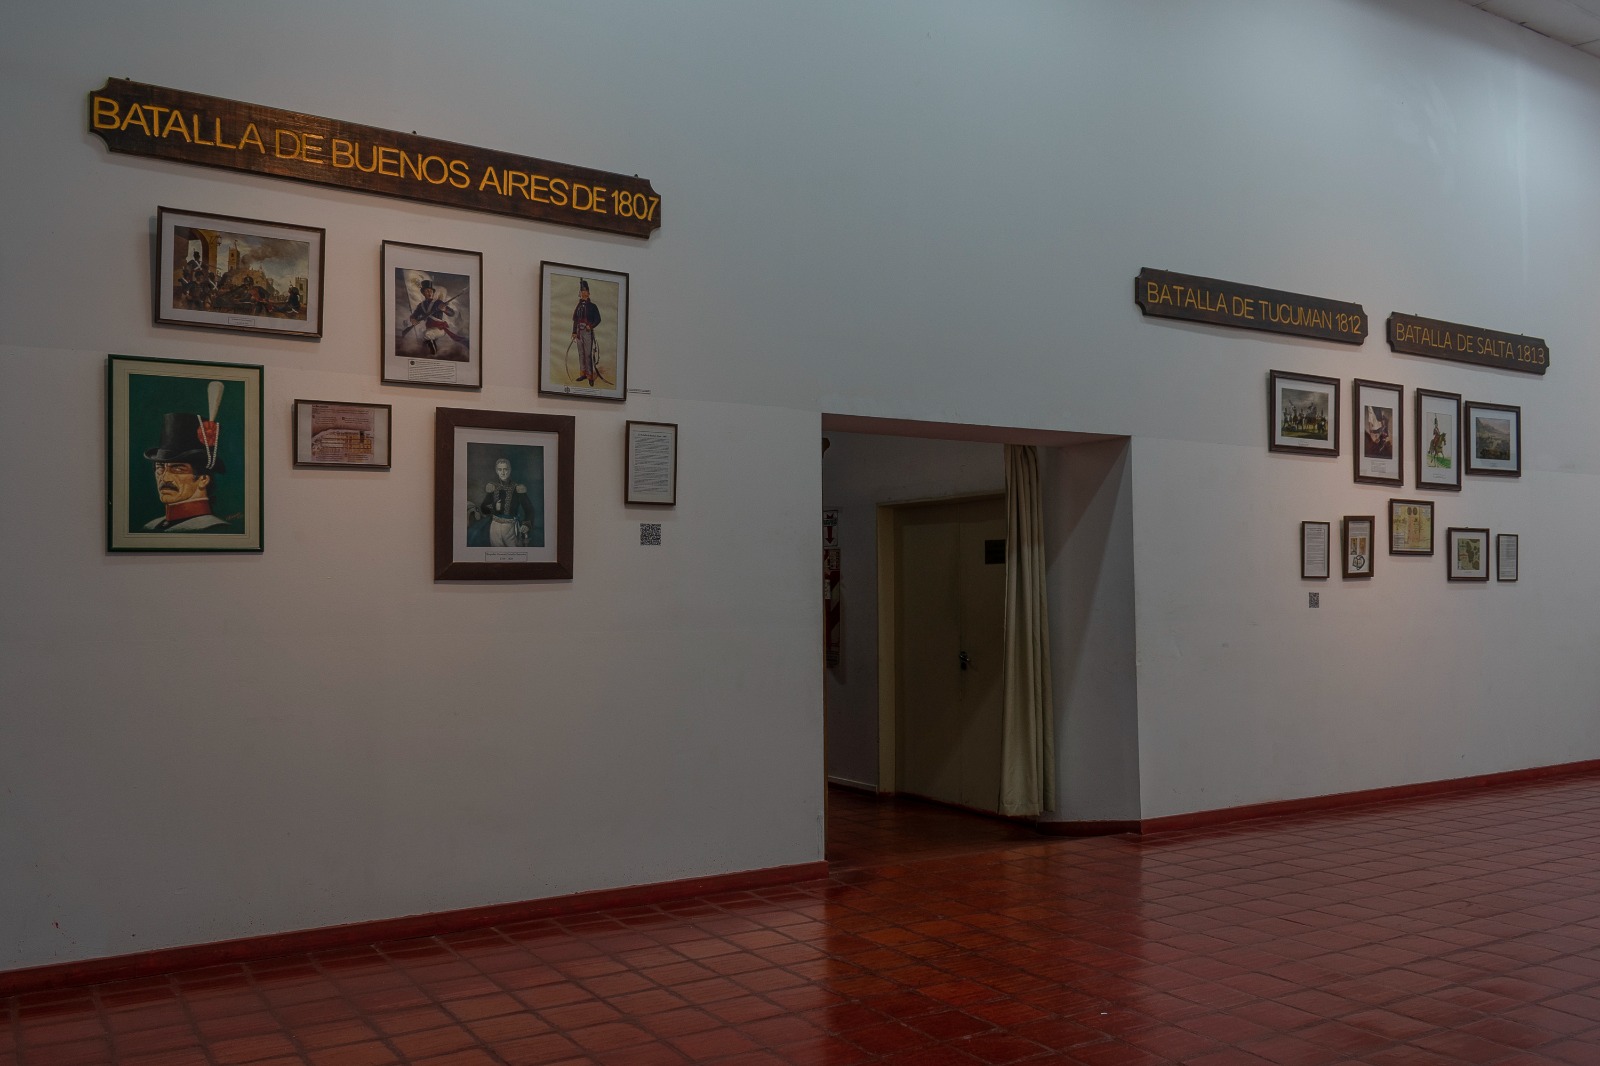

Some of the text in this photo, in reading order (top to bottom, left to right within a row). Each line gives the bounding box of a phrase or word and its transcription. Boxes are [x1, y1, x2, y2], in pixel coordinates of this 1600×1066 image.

[93, 96, 660, 221] BATALLA DE BUENOS AIRES DE 1807
[1147, 281, 1362, 334] BATALLA DE TUCUMAN 1812
[1396, 322, 1545, 365] BATALLA DE SALTA 1813
